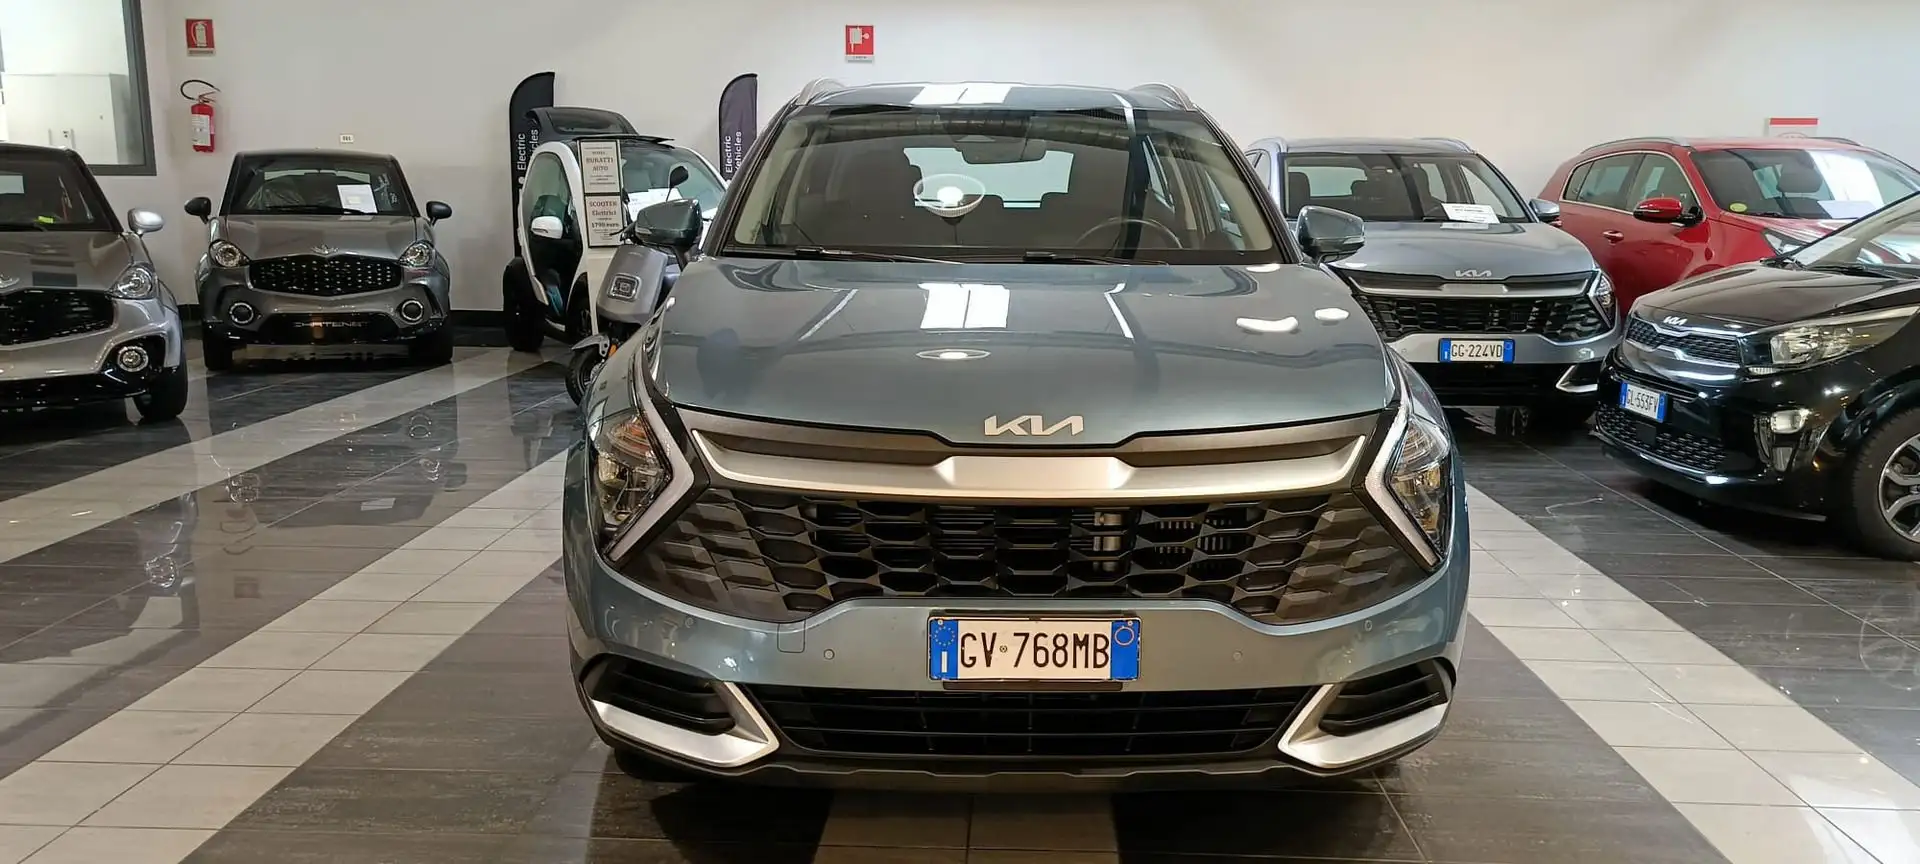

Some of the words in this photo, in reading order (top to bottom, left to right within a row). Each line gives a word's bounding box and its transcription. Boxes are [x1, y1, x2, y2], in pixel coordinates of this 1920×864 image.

[517, 133, 526, 170] Electric
[724, 135, 732, 173] Electric
[984, 415, 1084, 436] KIA
